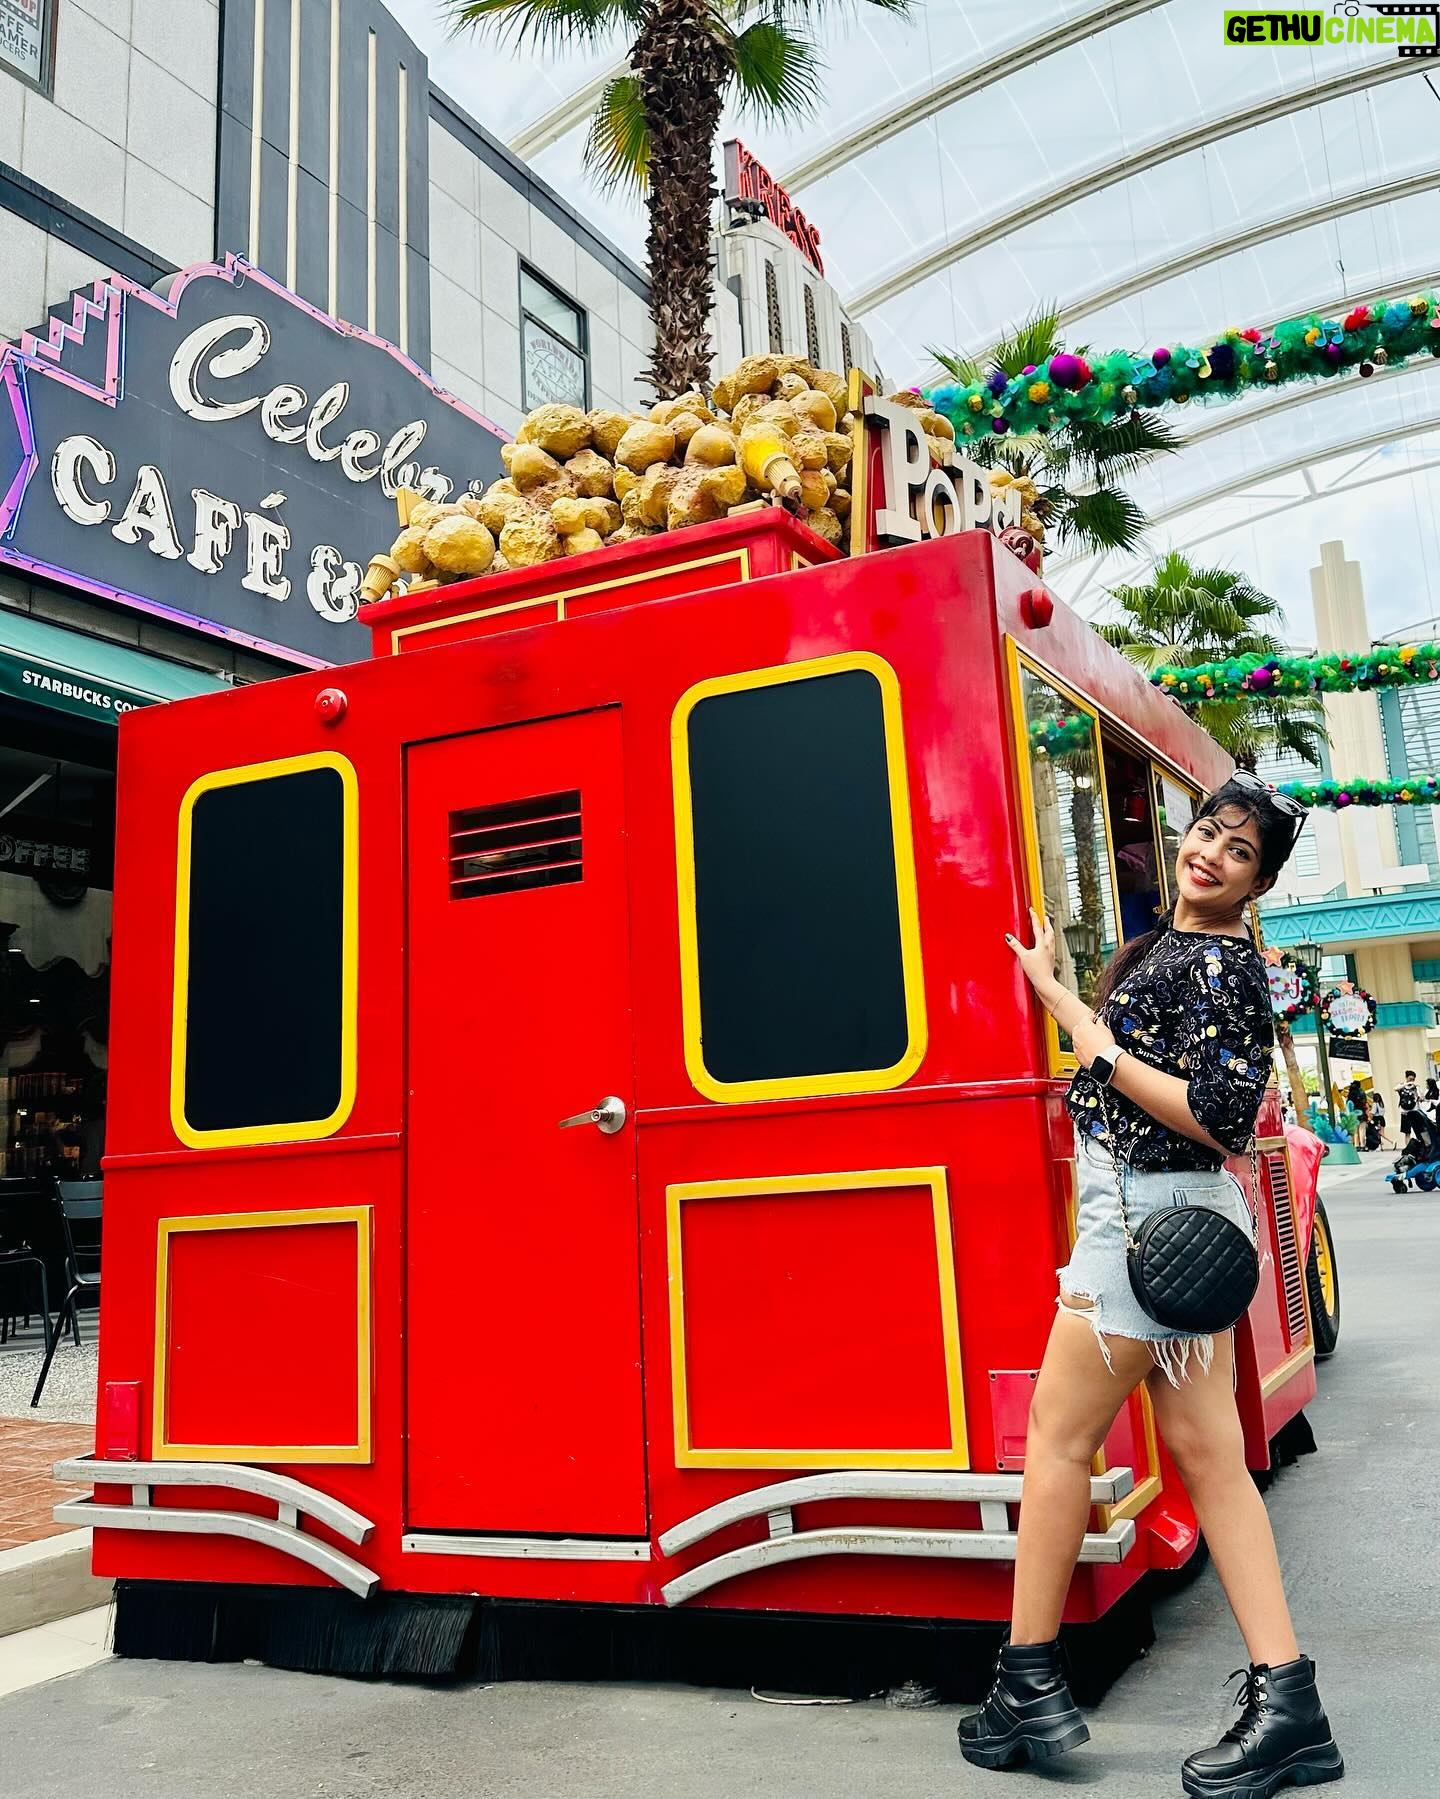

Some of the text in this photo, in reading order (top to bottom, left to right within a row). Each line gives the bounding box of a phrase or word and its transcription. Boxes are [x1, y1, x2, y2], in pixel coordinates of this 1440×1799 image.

[736, 137, 824, 280] KRESS
[51, 434, 364, 624] CAFÉ &
[22, 670, 141, 713] STARBUCKS CO
